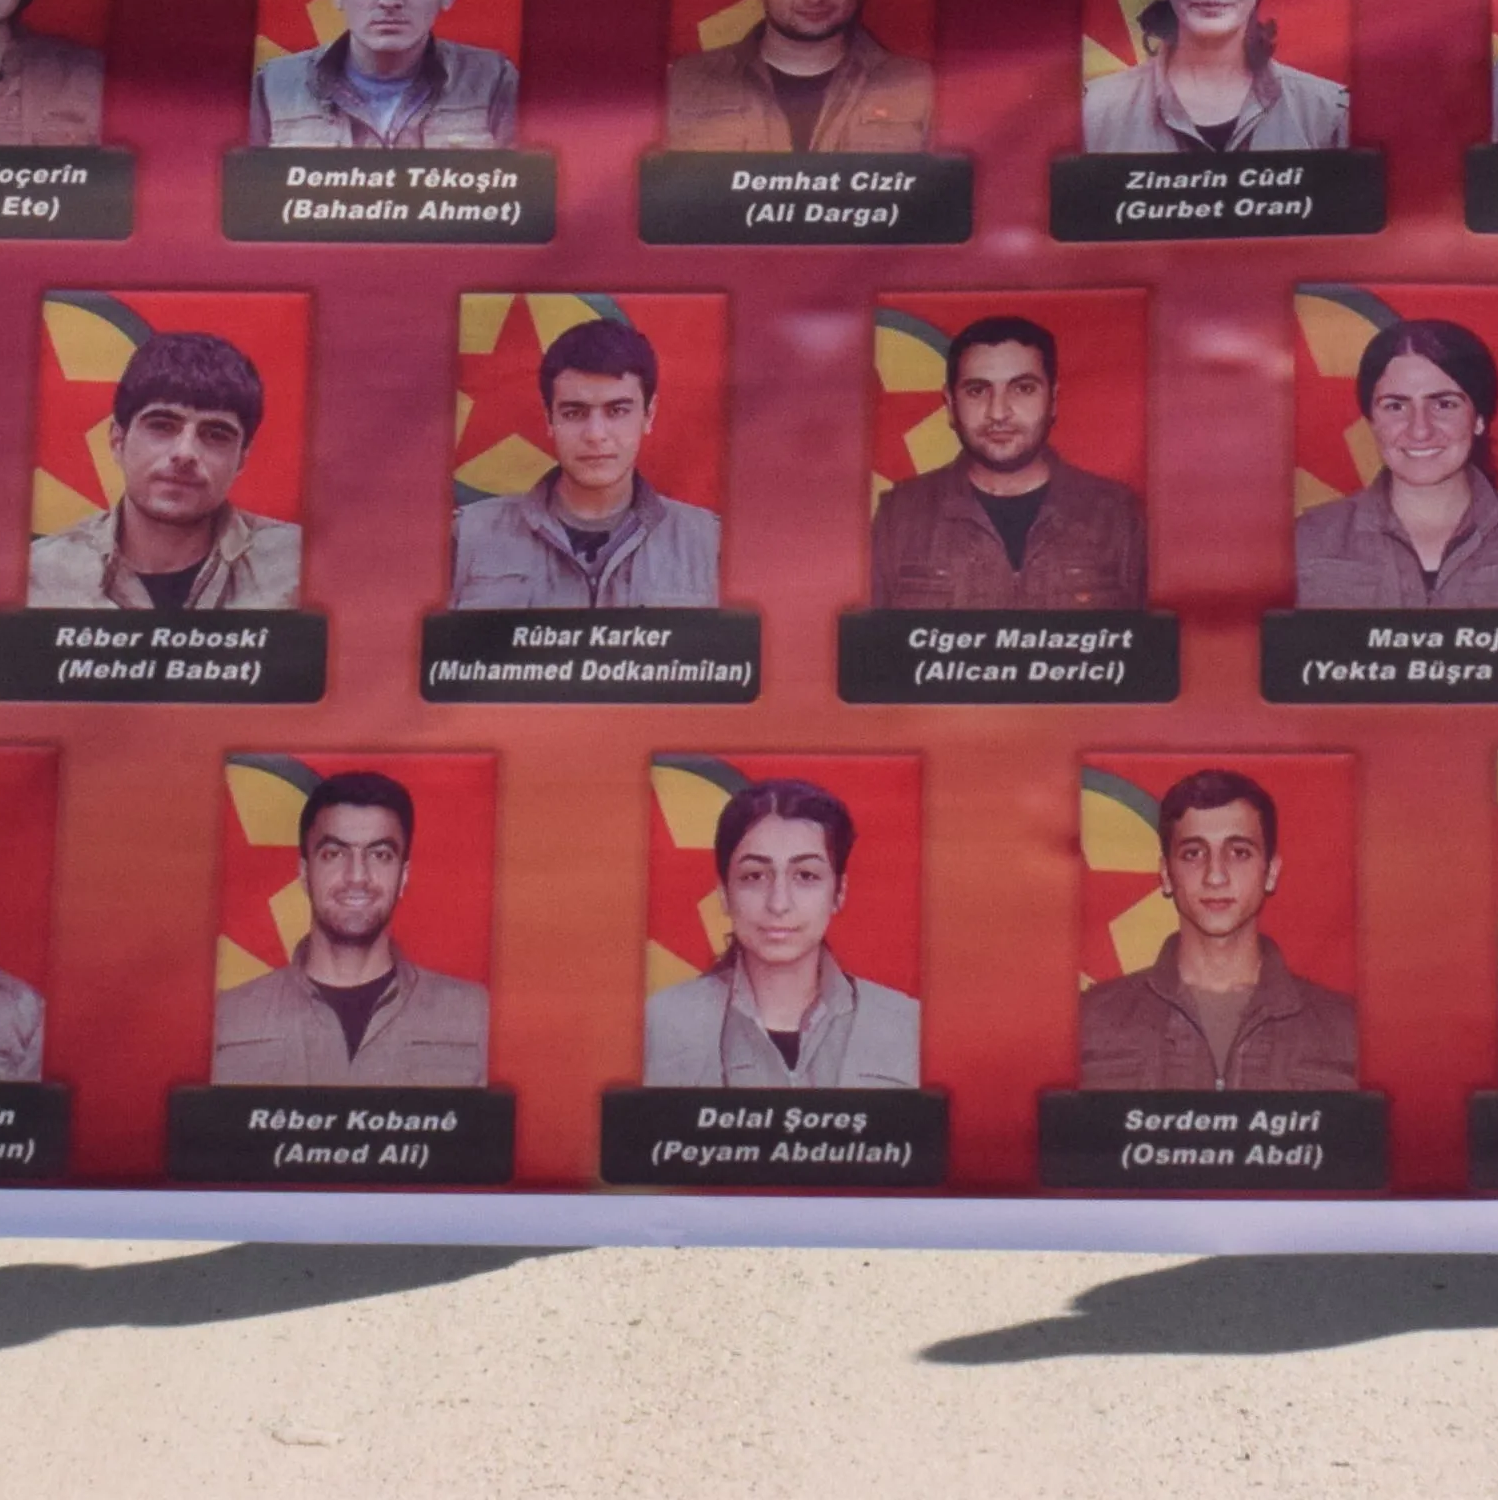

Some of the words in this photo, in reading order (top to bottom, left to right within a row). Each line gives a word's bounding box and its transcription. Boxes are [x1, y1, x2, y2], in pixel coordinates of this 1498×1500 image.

[287, 167, 396, 187] Demhat
[407, 167, 517, 192] Têkoşîn
[731, 171, 841, 191] Demhat
[1126, 170, 1227, 190] Zinarîn
[1239, 167, 1304, 187] Cûdî
[2, 197, 59, 221] Ete)
[418, 201, 521, 225] Ahmet)
[805, 204, 899, 227] Darga)
[1116, 201, 1224, 223] (Gurbet
[1234, 197, 1313, 218] Oran)
[56, 628, 142, 646] Rêber
[512, 626, 583, 646] Rûbar
[589, 626, 672, 646] Karker
[1367, 628, 1444, 648] Mava
[58, 660, 156, 682] (Mehdi
[165, 660, 260, 683] Babat)
[429, 661, 572, 685] (Muhammed
[915, 661, 1017, 684] (Alican
[1302, 661, 1395, 684] (Yekta
[1408, 661, 1492, 684] Büşra
[249, 1110, 338, 1130] Rêber
[697, 1108, 773, 1128] Delal
[783, 1108, 867, 1133] Şoreş
[1125, 1110, 1238, 1130] Serdem
[274, 1143, 370, 1167] (Amed
[651, 1141, 760, 1165] (Peyam
[770, 1142, 912, 1166] Abdullah)
[1121, 1144, 1233, 1168] (Osman
